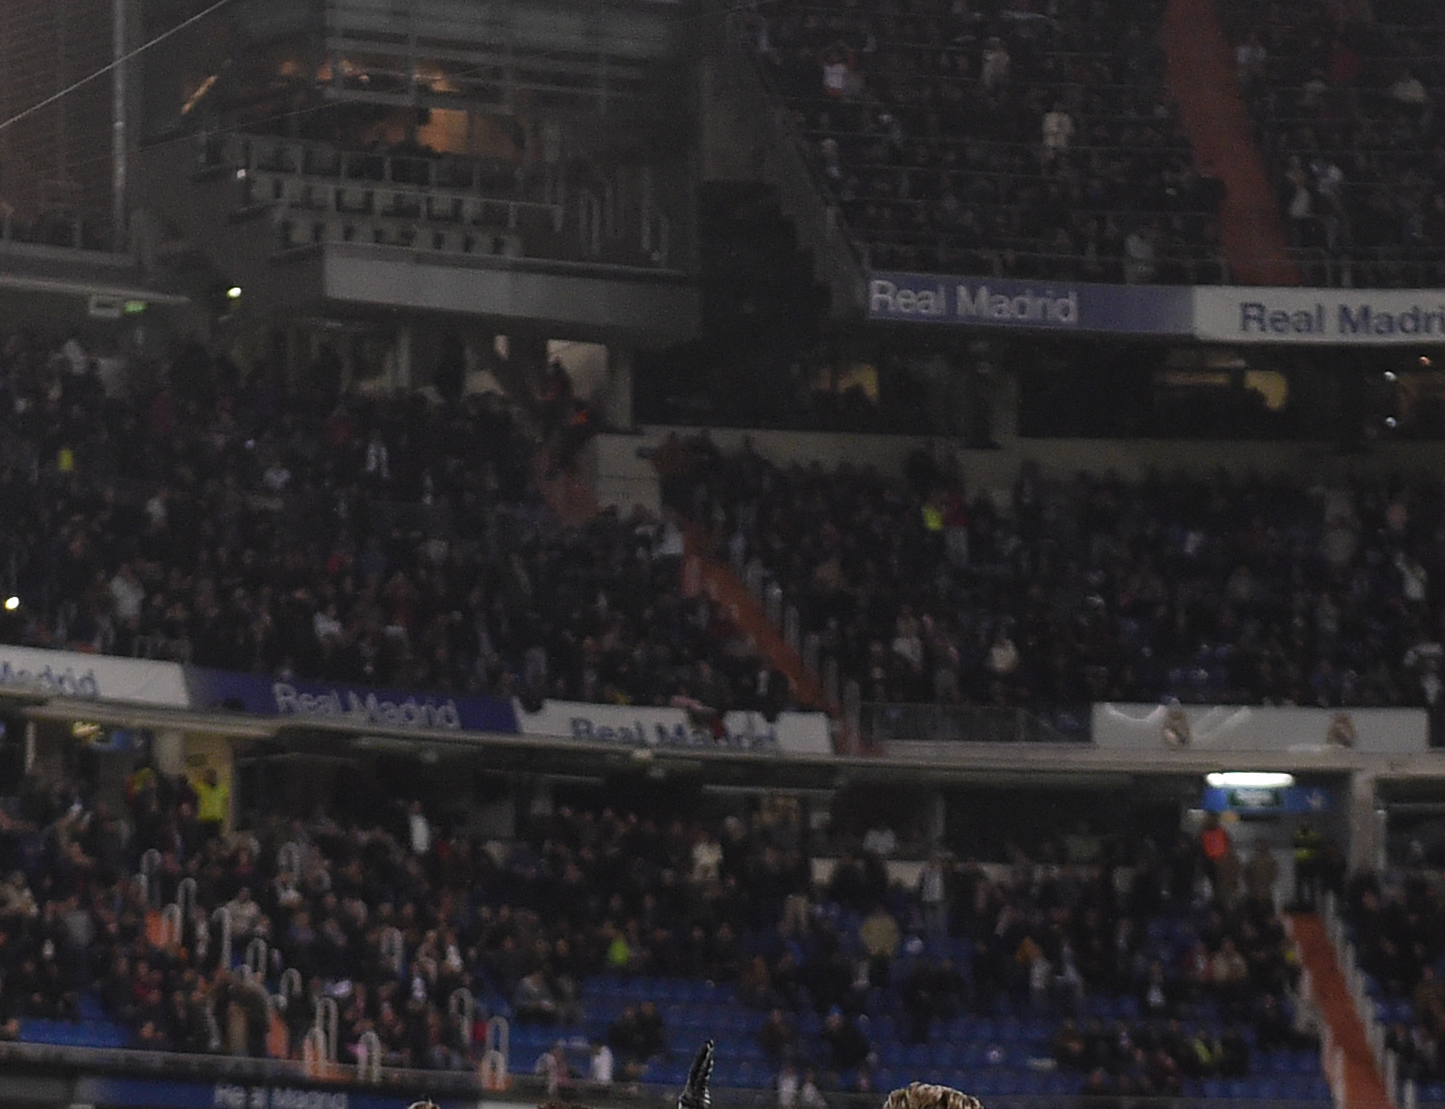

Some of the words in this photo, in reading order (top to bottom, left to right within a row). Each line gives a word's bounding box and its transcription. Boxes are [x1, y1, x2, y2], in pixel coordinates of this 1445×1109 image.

[869, 279, 946, 316] Real
[956, 284, 1078, 323] Madrid
[1240, 302, 1324, 334] Real
[273, 683, 342, 716] Real
